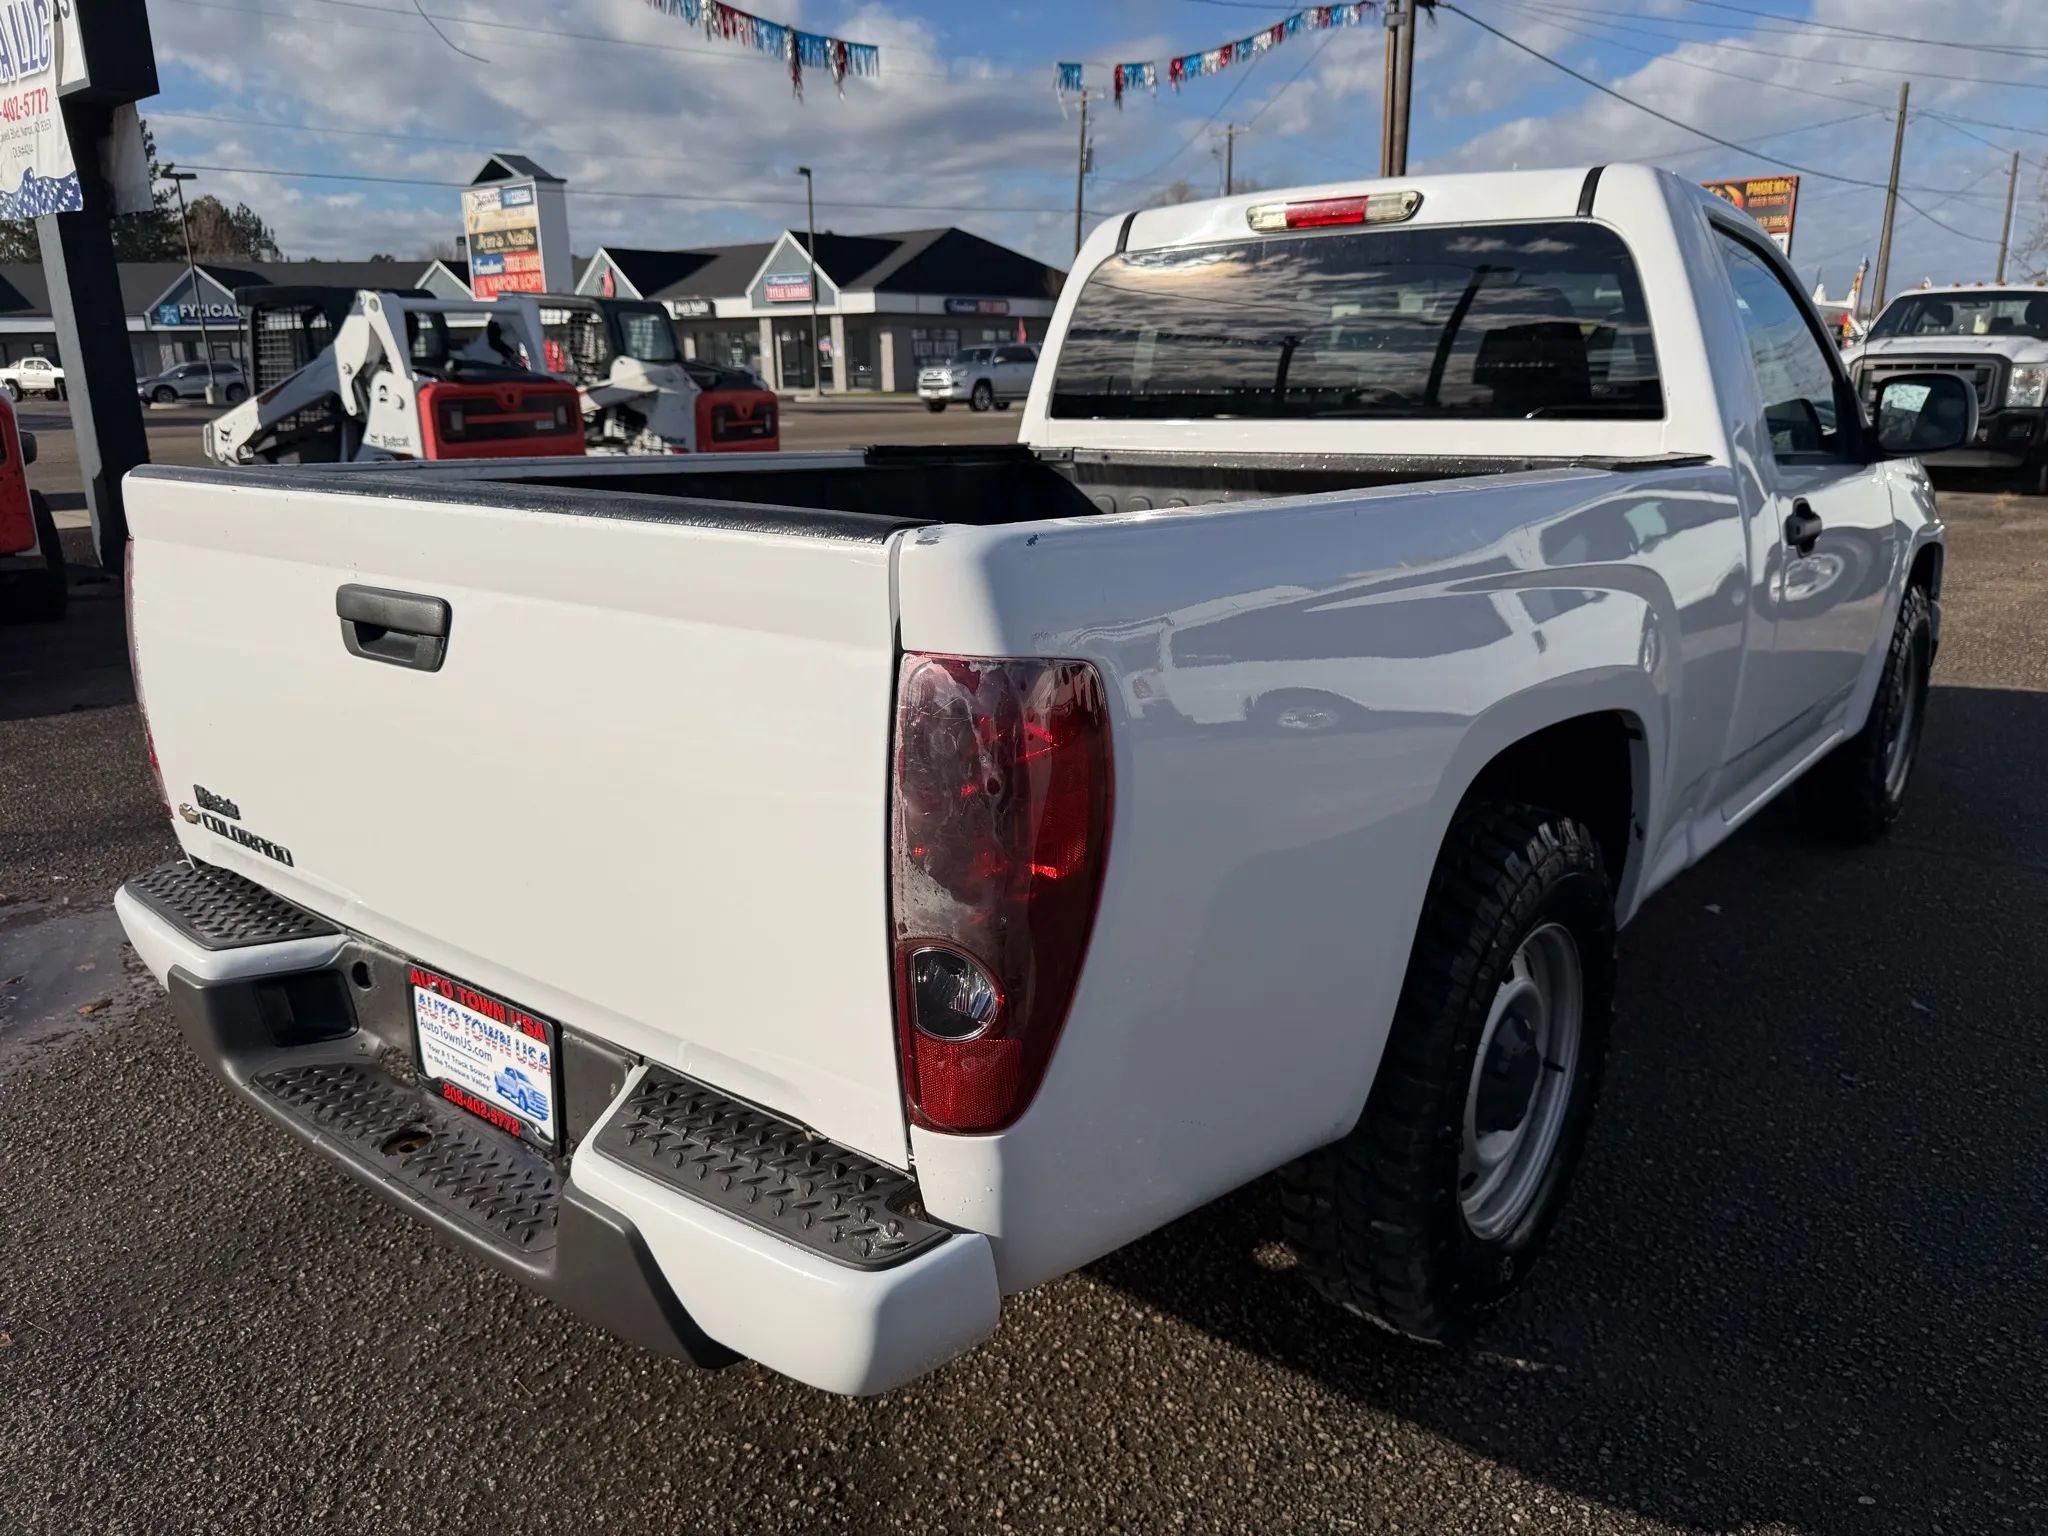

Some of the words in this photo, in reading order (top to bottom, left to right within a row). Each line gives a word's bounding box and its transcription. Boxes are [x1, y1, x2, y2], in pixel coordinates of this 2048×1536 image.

[8, 0, 50, 75] LLC
[201, 812, 294, 867] COLORADO
[410, 967, 455, 1000] AUTO
[457, 985, 507, 1024] TOWN
[510, 1008, 546, 1041] USA
[417, 993, 461, 1030] AUTO
[462, 1012, 512, 1058] TOWN
[515, 1039, 551, 1077] USA
[420, 1016, 493, 1063] AutoTownUS.com
[444, 1061, 470, 1080] Treasure
[452, 1055, 468, 1069] Truck
[469, 1064, 491, 1081] Source
